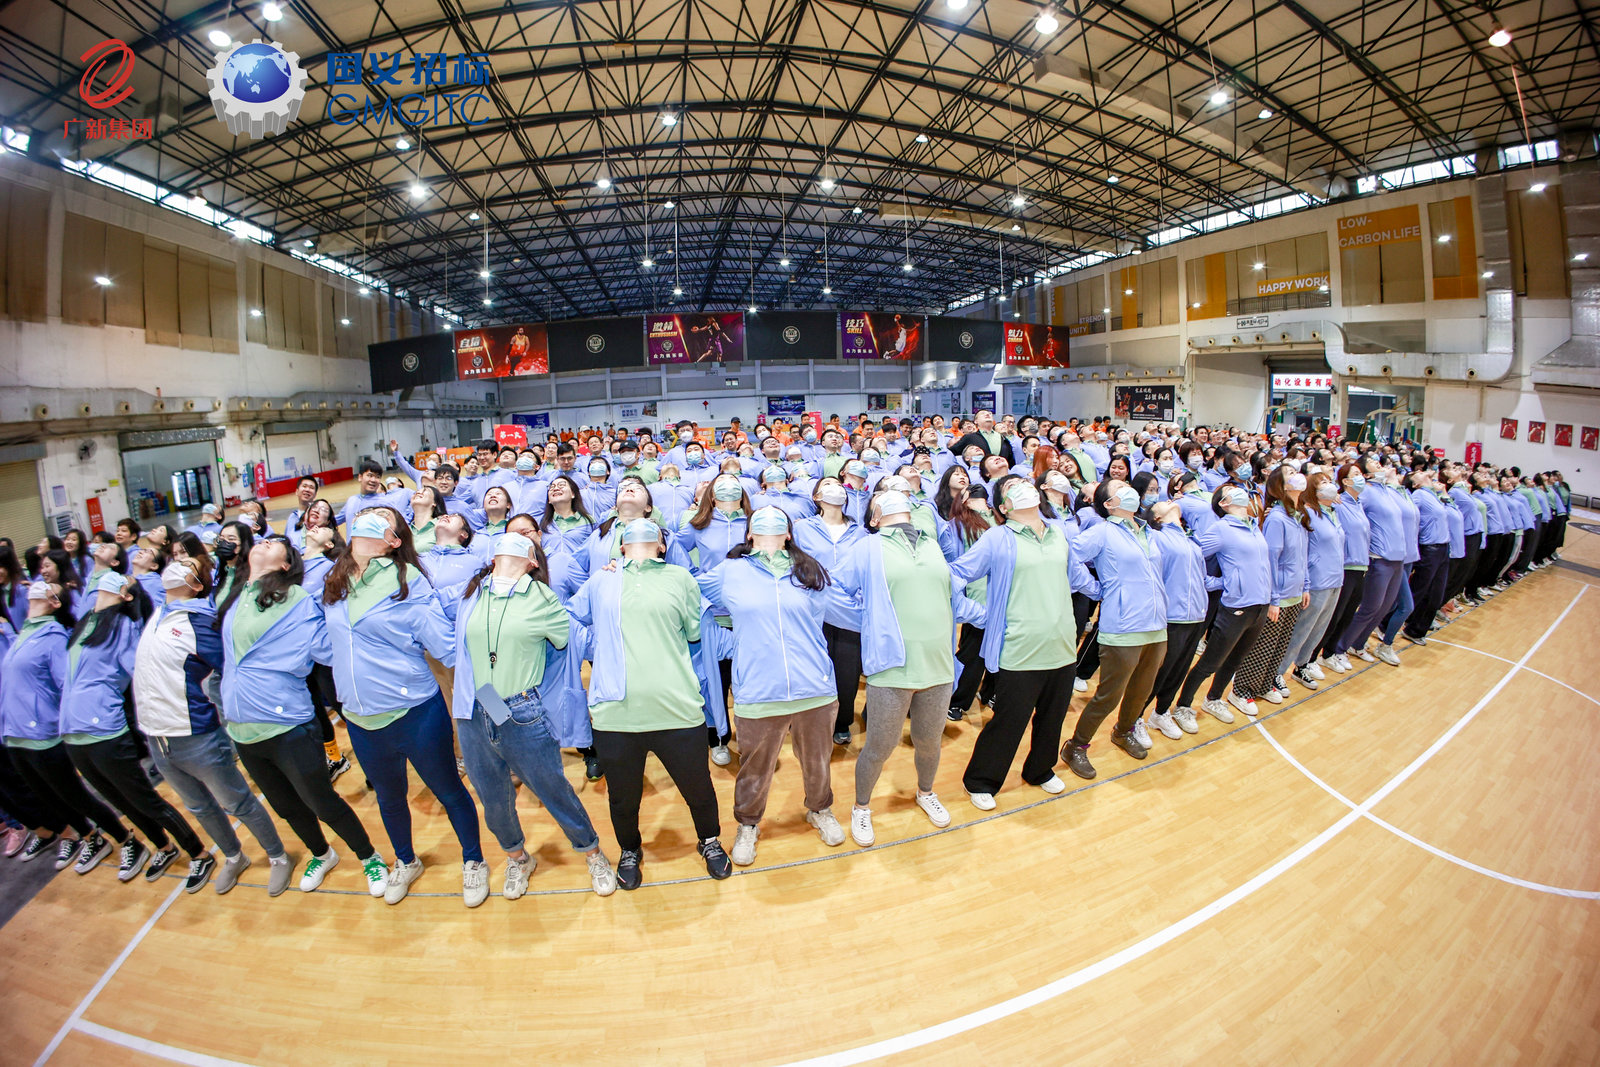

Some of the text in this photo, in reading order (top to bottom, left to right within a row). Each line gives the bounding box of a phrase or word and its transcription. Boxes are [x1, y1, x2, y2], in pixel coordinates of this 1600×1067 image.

[1340, 216, 1372, 230] LOW-
[1339, 225, 1420, 247] CARBON LIFE
[1258, 275, 1329, 294] HAPPY WORK
